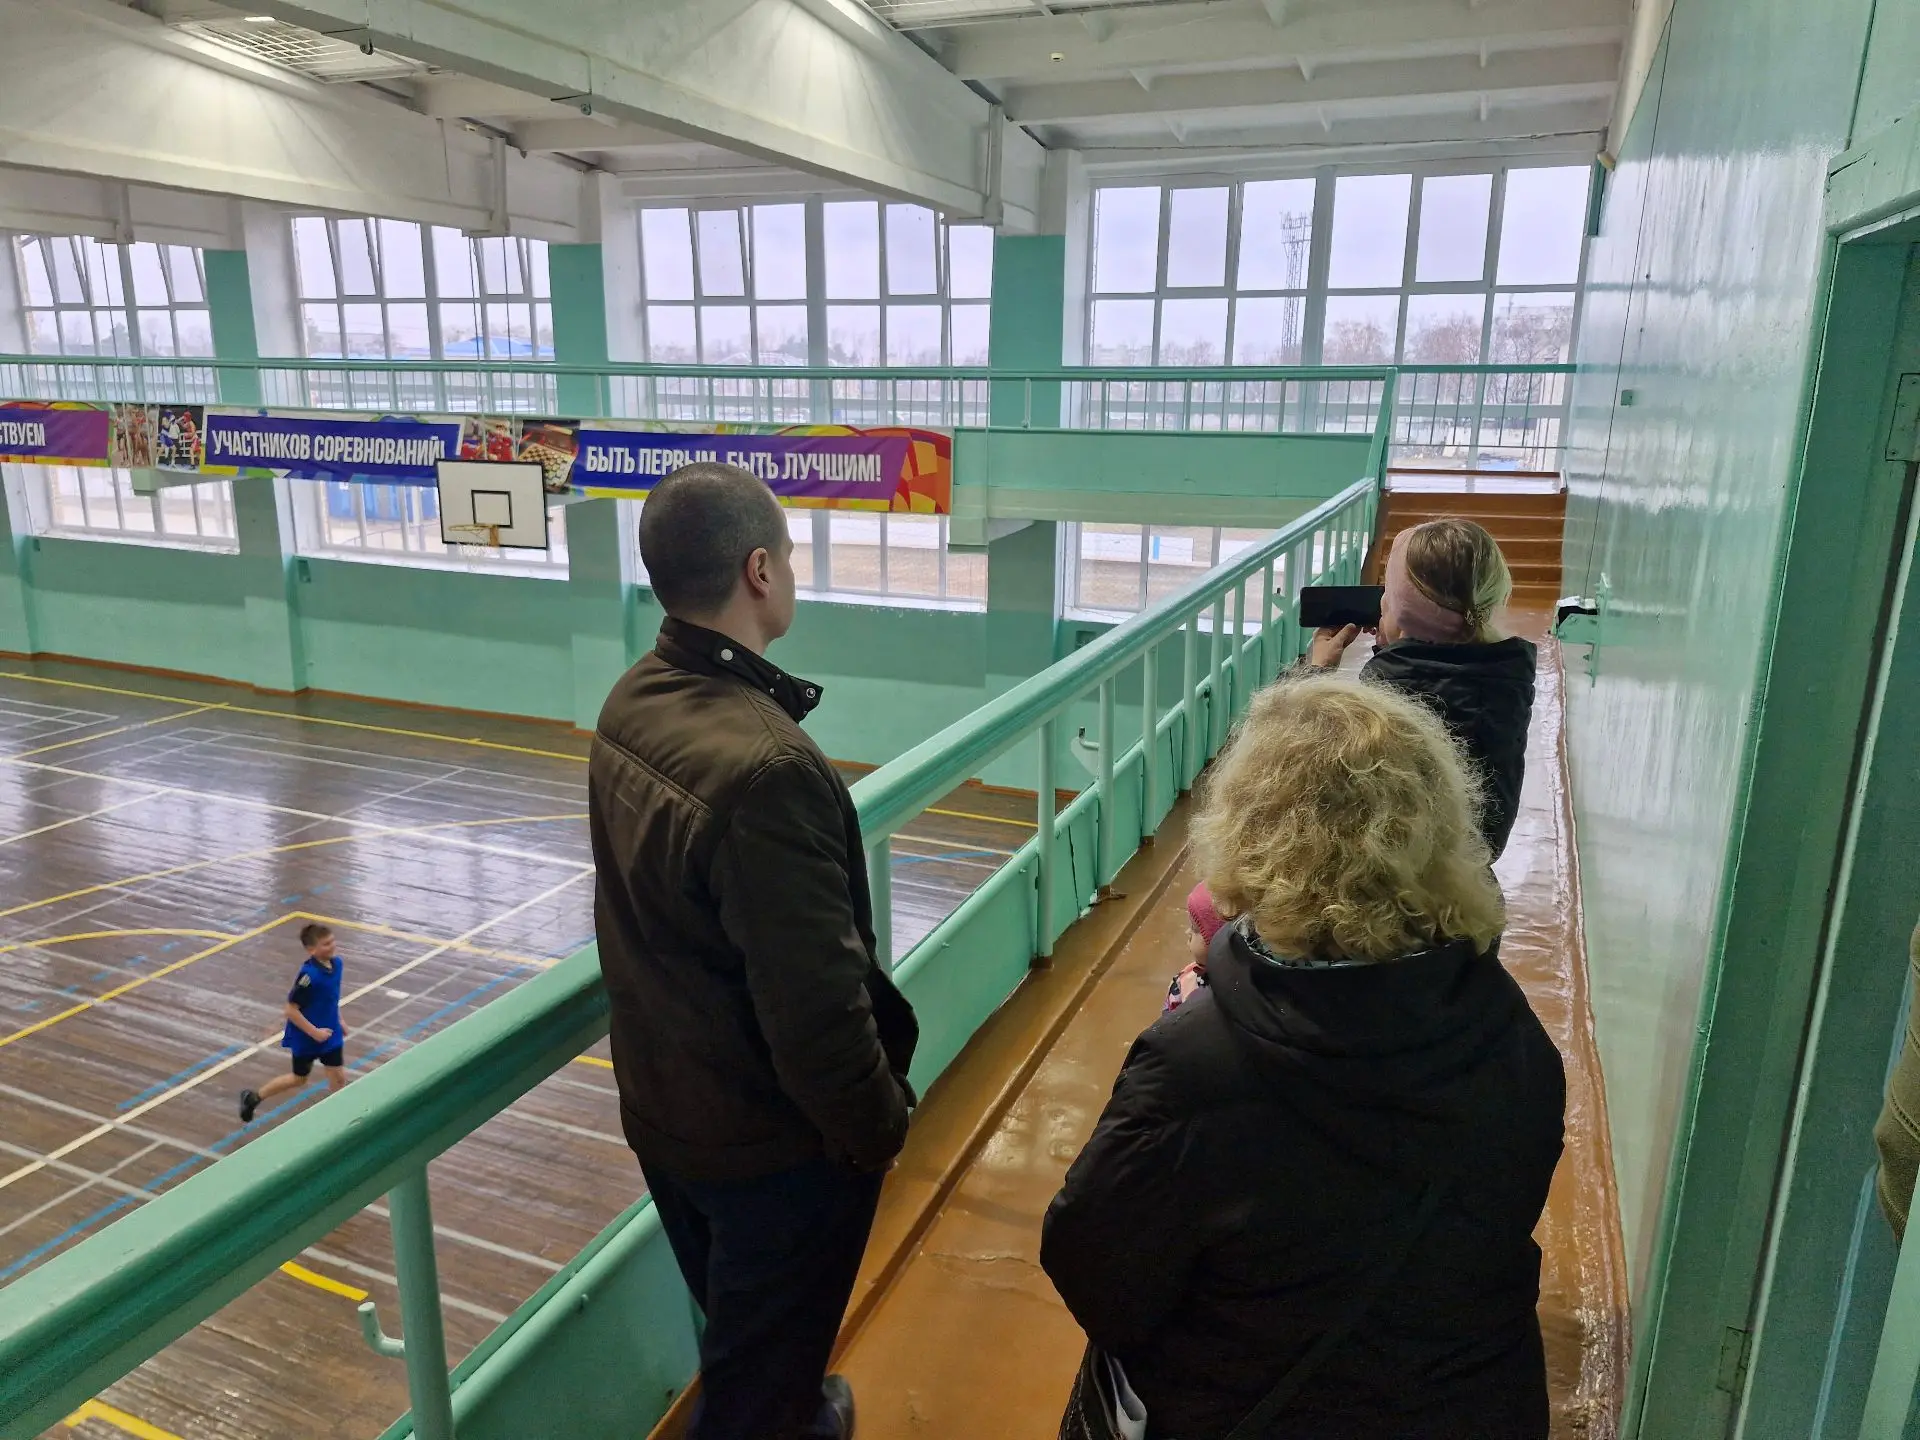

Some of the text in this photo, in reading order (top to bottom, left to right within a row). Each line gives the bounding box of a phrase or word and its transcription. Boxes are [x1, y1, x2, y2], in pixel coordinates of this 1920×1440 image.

[212, 429, 446, 467] УЧАСТНИКОВ СОРЕВНОВАНИЙ!
[586, 446, 636, 474] БЫТЬ
[781, 452, 882, 482] ЛУЧШИМ!
